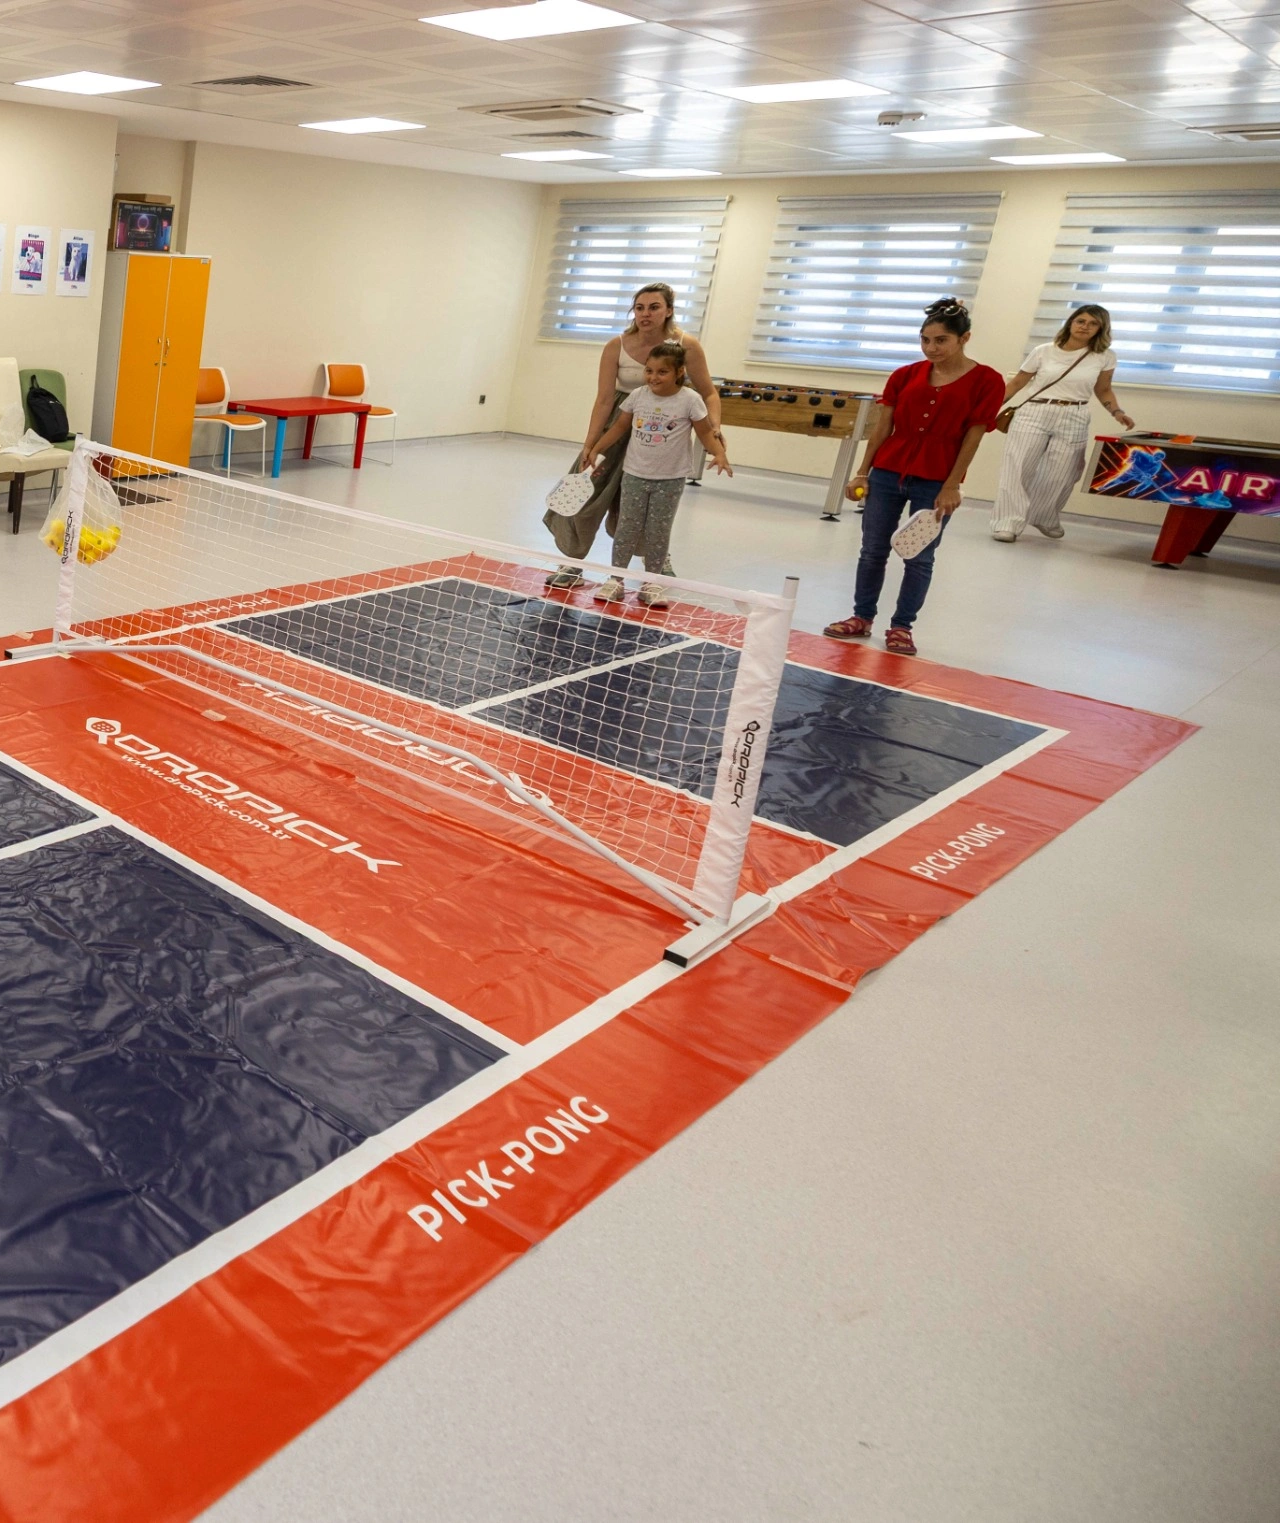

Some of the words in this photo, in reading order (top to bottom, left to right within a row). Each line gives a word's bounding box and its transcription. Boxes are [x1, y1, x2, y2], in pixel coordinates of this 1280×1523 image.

[1179, 468, 1273, 498] AIR
[121, 754, 292, 841] www.dropick.com.tr
[909, 822, 1006, 881] PICK-PONG
[407, 1096, 609, 1243] PICK-PONG
